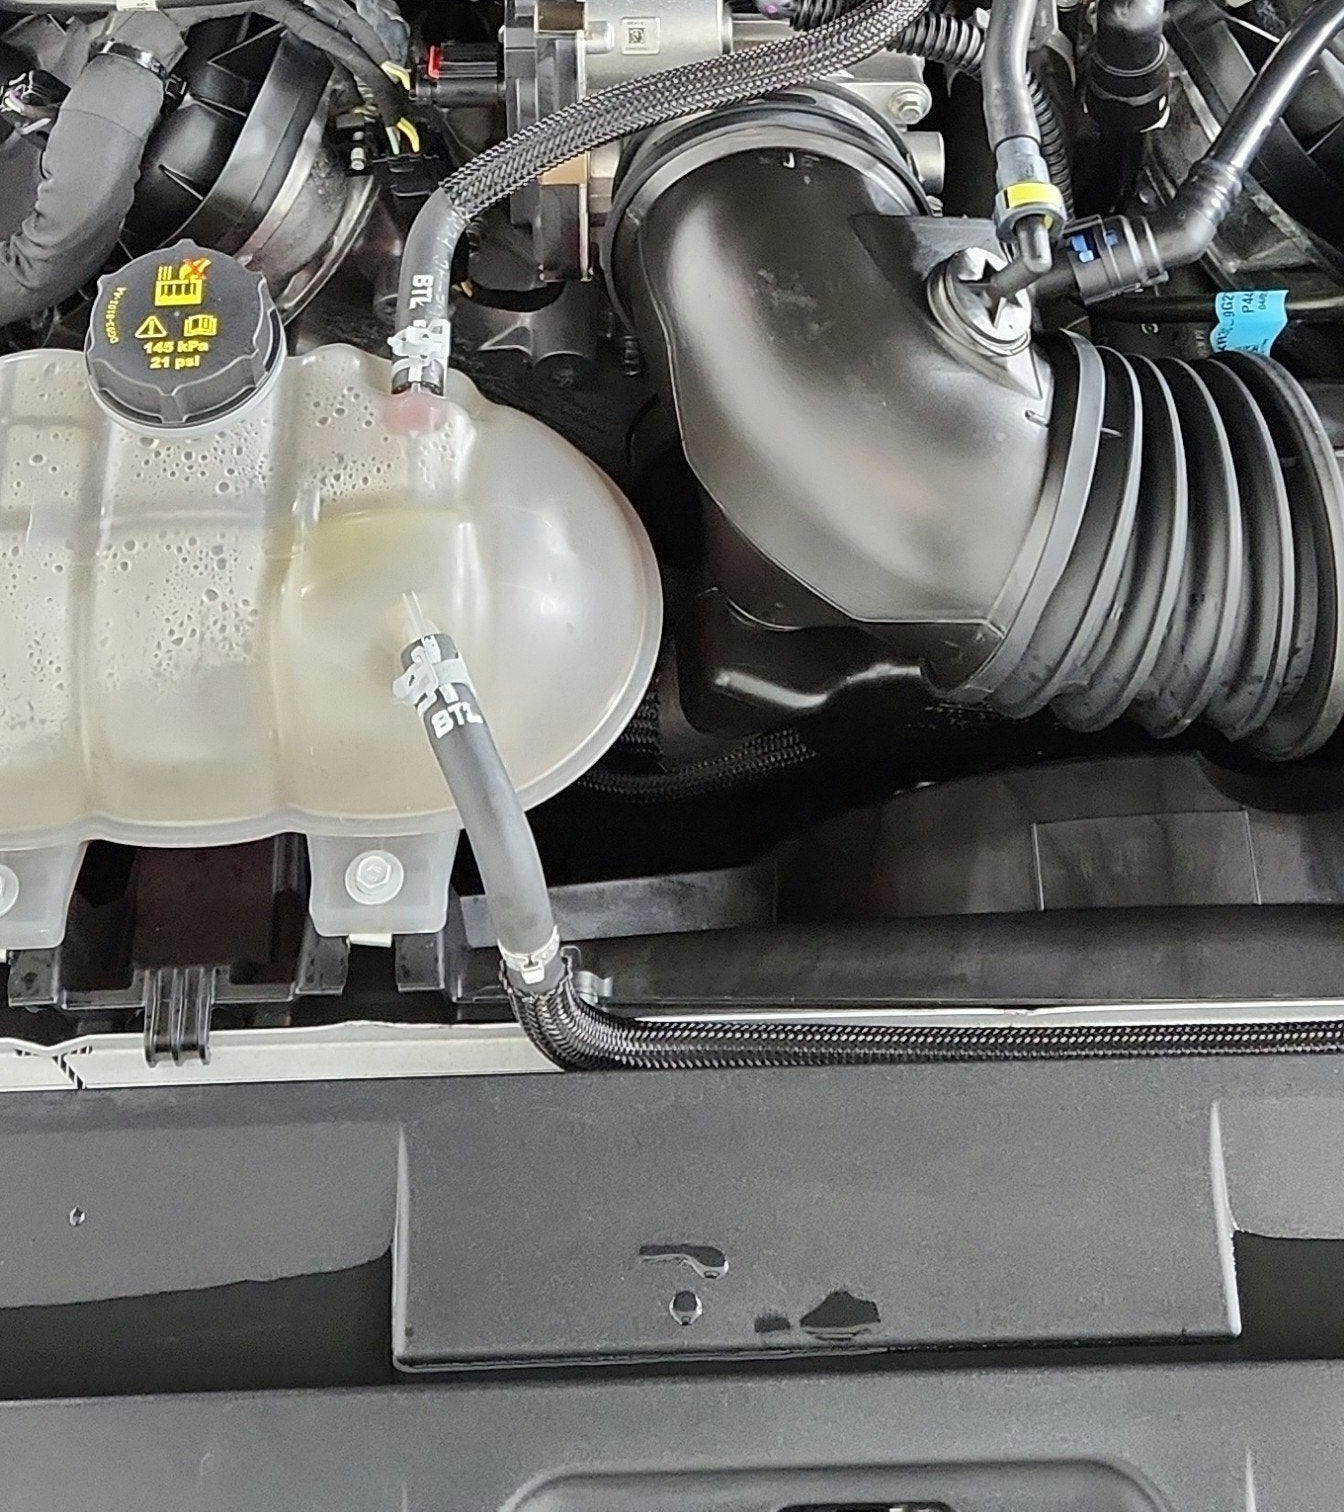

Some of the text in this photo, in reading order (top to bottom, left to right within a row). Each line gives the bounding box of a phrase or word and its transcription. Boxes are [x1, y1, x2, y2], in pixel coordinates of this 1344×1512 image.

[143, 340, 209, 354] 145 kPa
[150, 356, 200, 370] 21 psi
